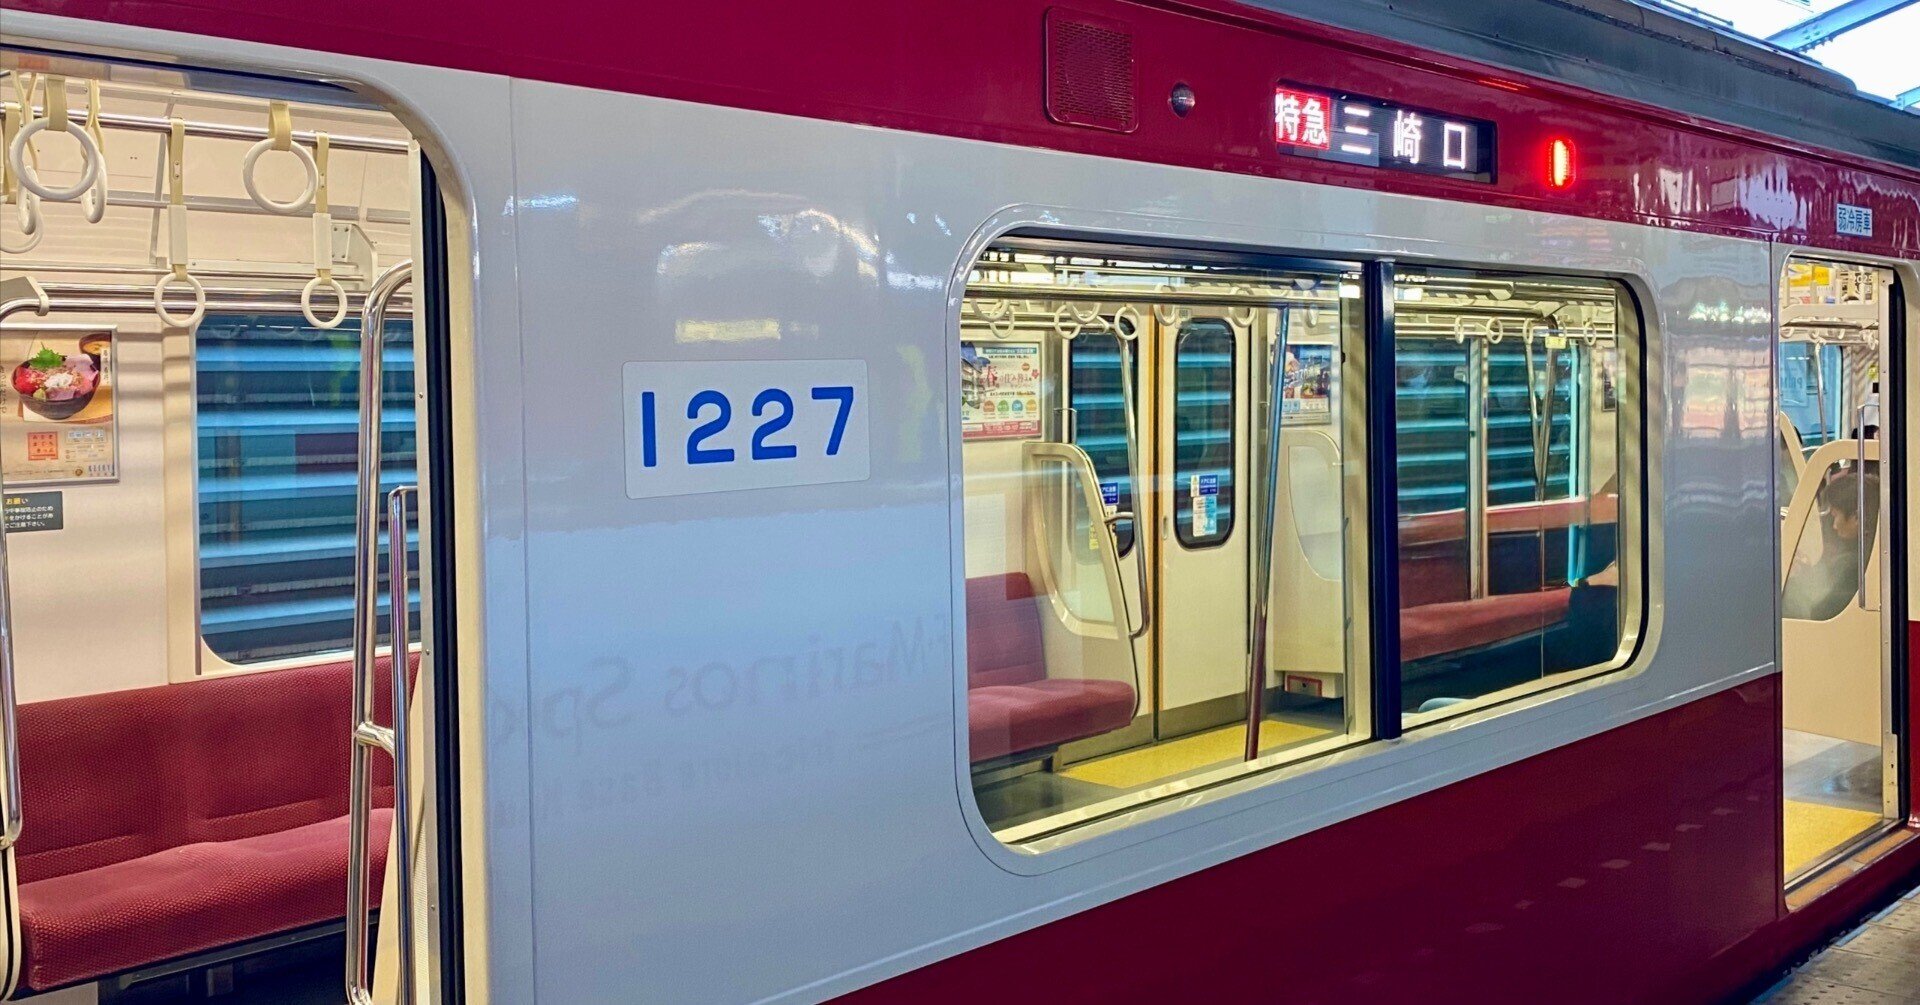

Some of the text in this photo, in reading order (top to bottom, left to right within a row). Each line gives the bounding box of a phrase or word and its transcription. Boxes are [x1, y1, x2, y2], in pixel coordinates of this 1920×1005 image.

[1275, 92, 1467, 170] 特急 三崎口
[1838, 206, 1871, 233] 弱冷房車
[641, 386, 854, 468] 1227
